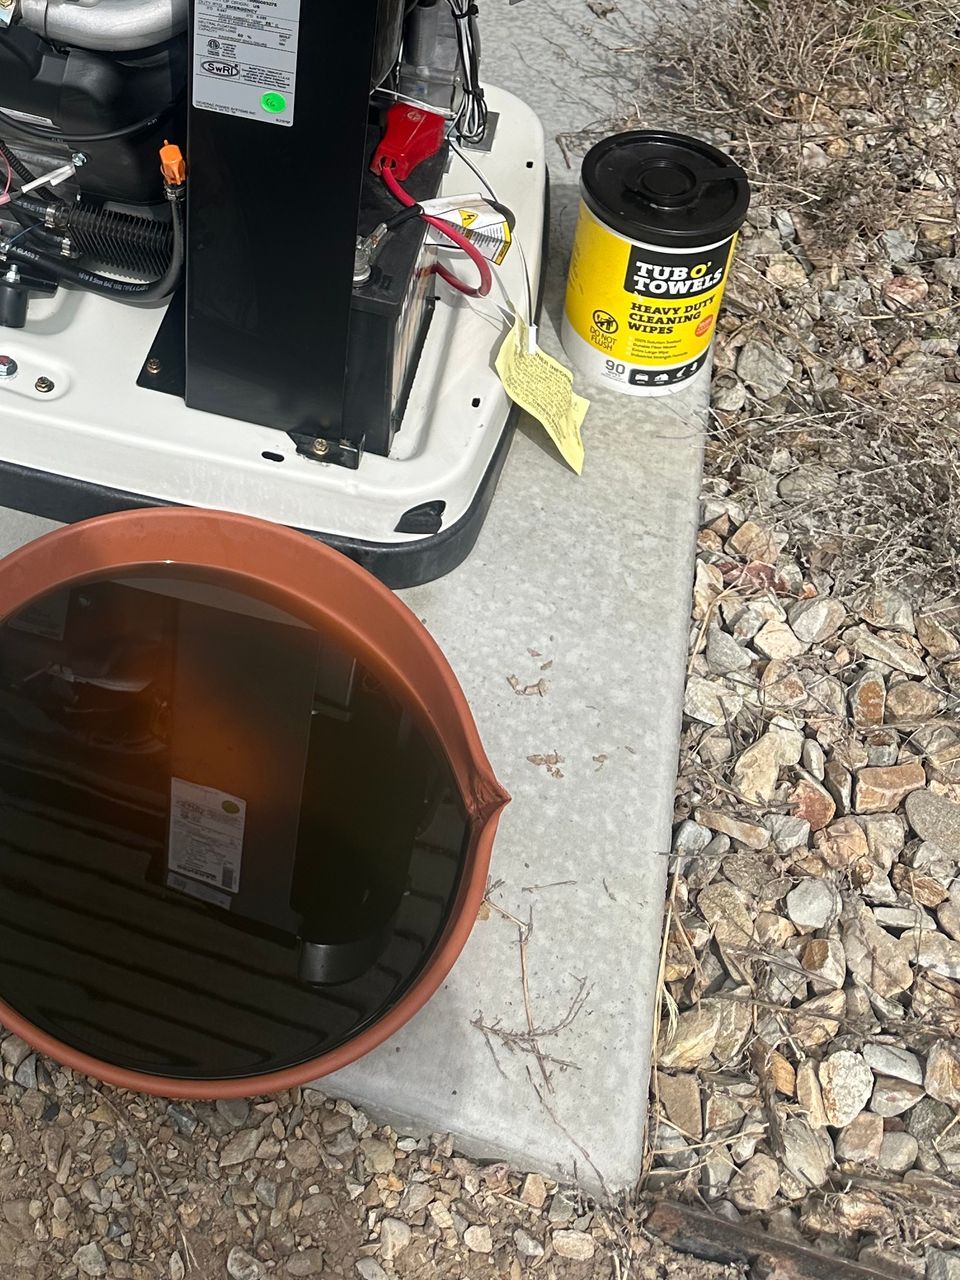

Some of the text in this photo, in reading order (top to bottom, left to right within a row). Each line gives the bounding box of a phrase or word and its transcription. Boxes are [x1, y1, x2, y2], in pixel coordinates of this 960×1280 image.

[226, 5, 257, 14] EMERGENCY
[16, 247, 35, 259] CLASS
[636, 261, 712, 281] TUB O'
[633, 268, 723, 295] TOWELS
[630, 294, 716, 315] HEAVY DUTY
[629, 311, 701, 325] CLEANING
[589, 325, 617, 345] DO NOT
[628, 321, 674, 335] WIPES
[591, 335, 613, 351] FLUSH
[605, 360, 625, 375] 90
